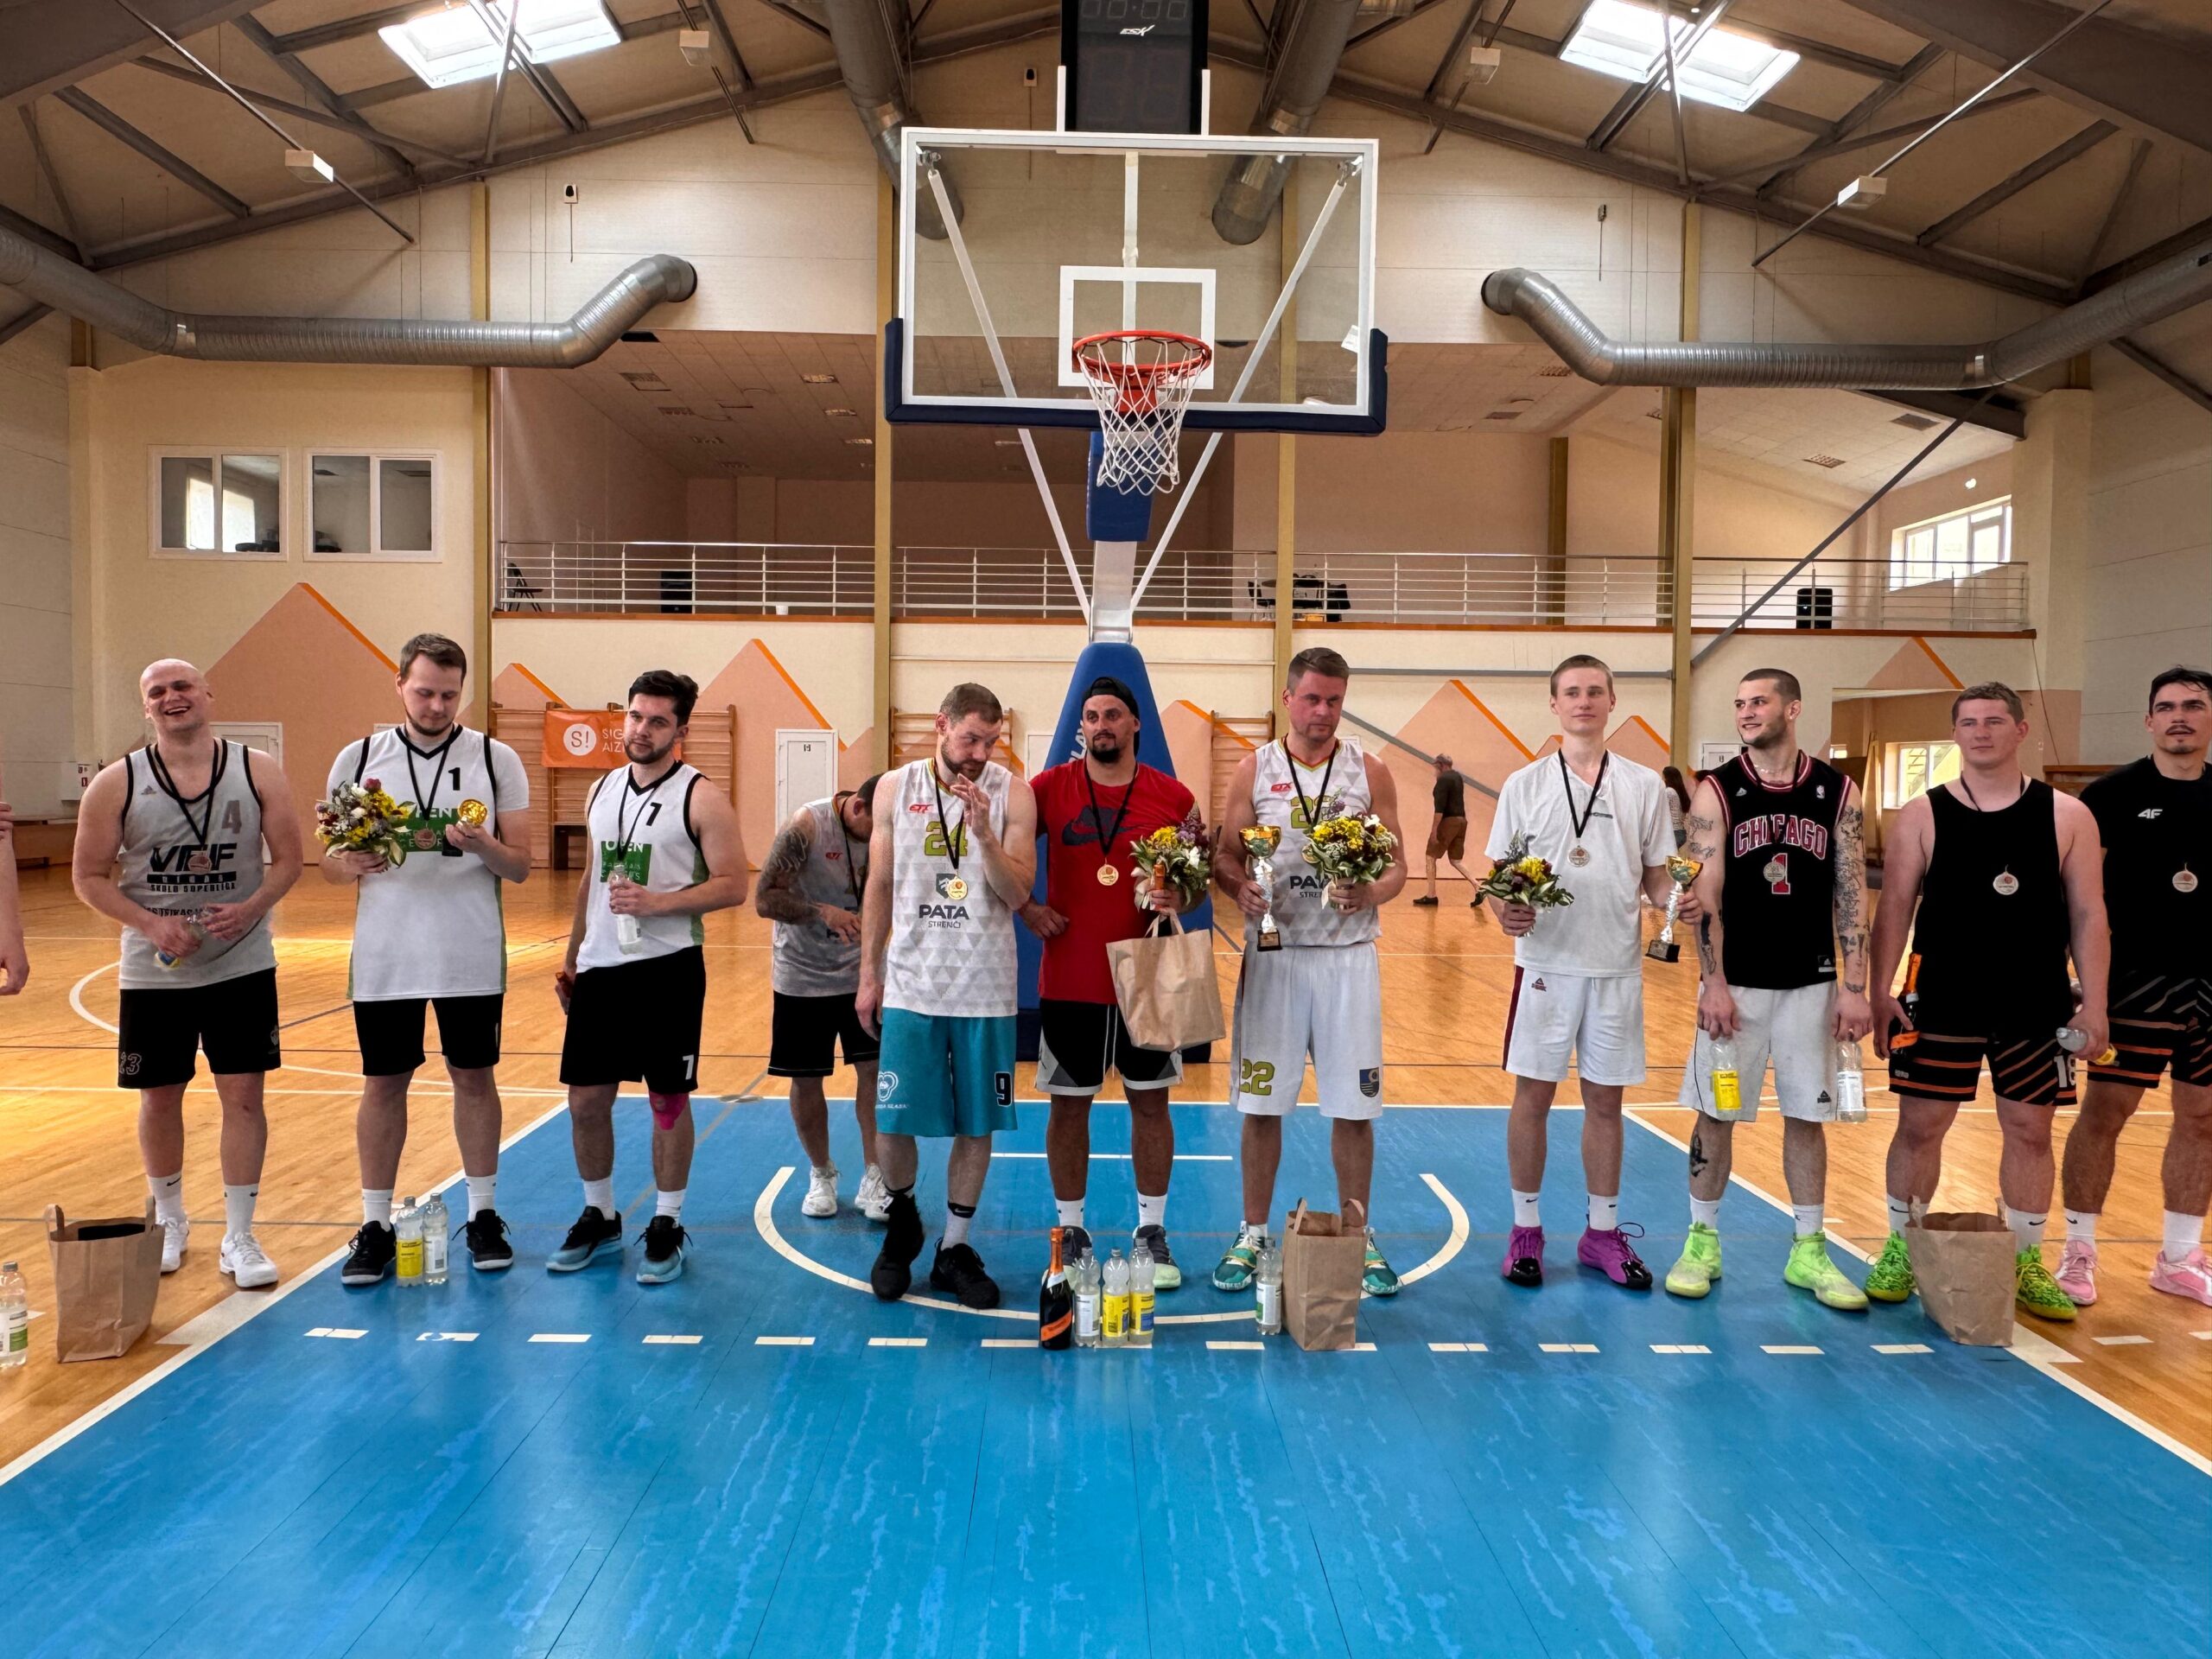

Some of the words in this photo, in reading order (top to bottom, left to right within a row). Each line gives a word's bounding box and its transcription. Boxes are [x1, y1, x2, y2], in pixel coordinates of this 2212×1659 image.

[601, 728, 625, 740] SIG
[601, 741, 626, 753] AIZ
[448, 766, 461, 791] 1
[220, 799, 242, 834] 4
[645, 801, 663, 827] 7
[2137, 808, 2164, 819] 4F
[924, 821, 969, 857] 24
[1733, 813, 1828, 861] CHICAGO
[918, 904, 969, 920] PATA
[682, 1053, 695, 1080] 7
[994, 1071, 1014, 1108] 9
